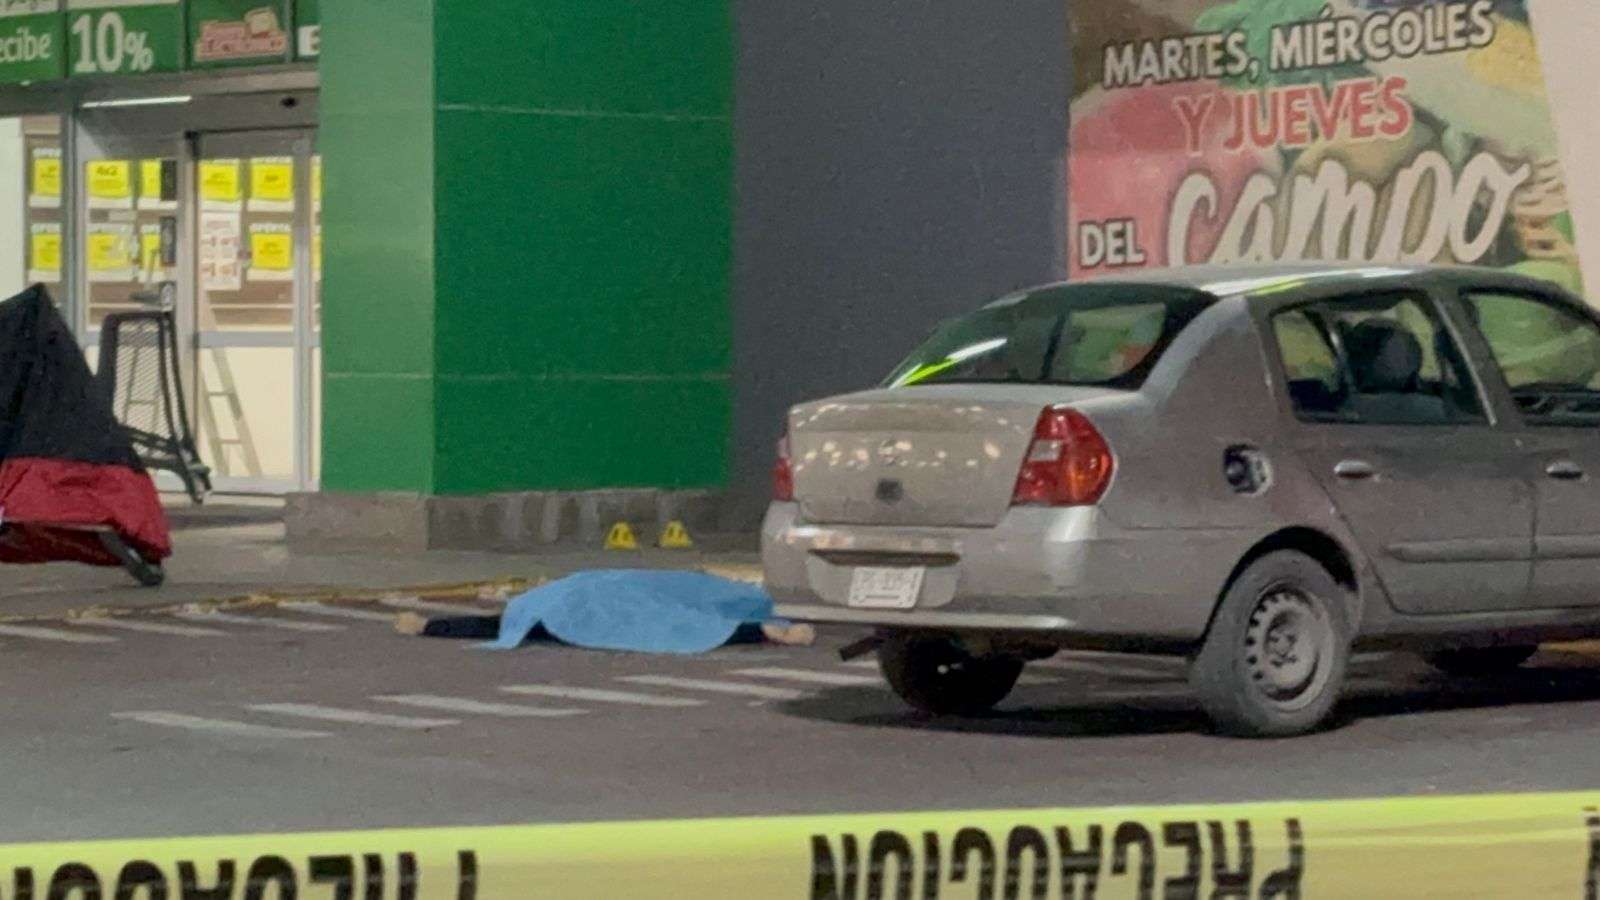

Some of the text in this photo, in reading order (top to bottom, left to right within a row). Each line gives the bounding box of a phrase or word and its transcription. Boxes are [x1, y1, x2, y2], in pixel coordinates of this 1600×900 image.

[71, 11, 154, 72] 10%
[1102, 1, 1495, 89] MARTES, MIÉRCOLES
[1174, 76, 1412, 156] Y JUEVES
[1079, 220, 1146, 267] DEL
[810, 819, 1304, 900] PRECAUCION
